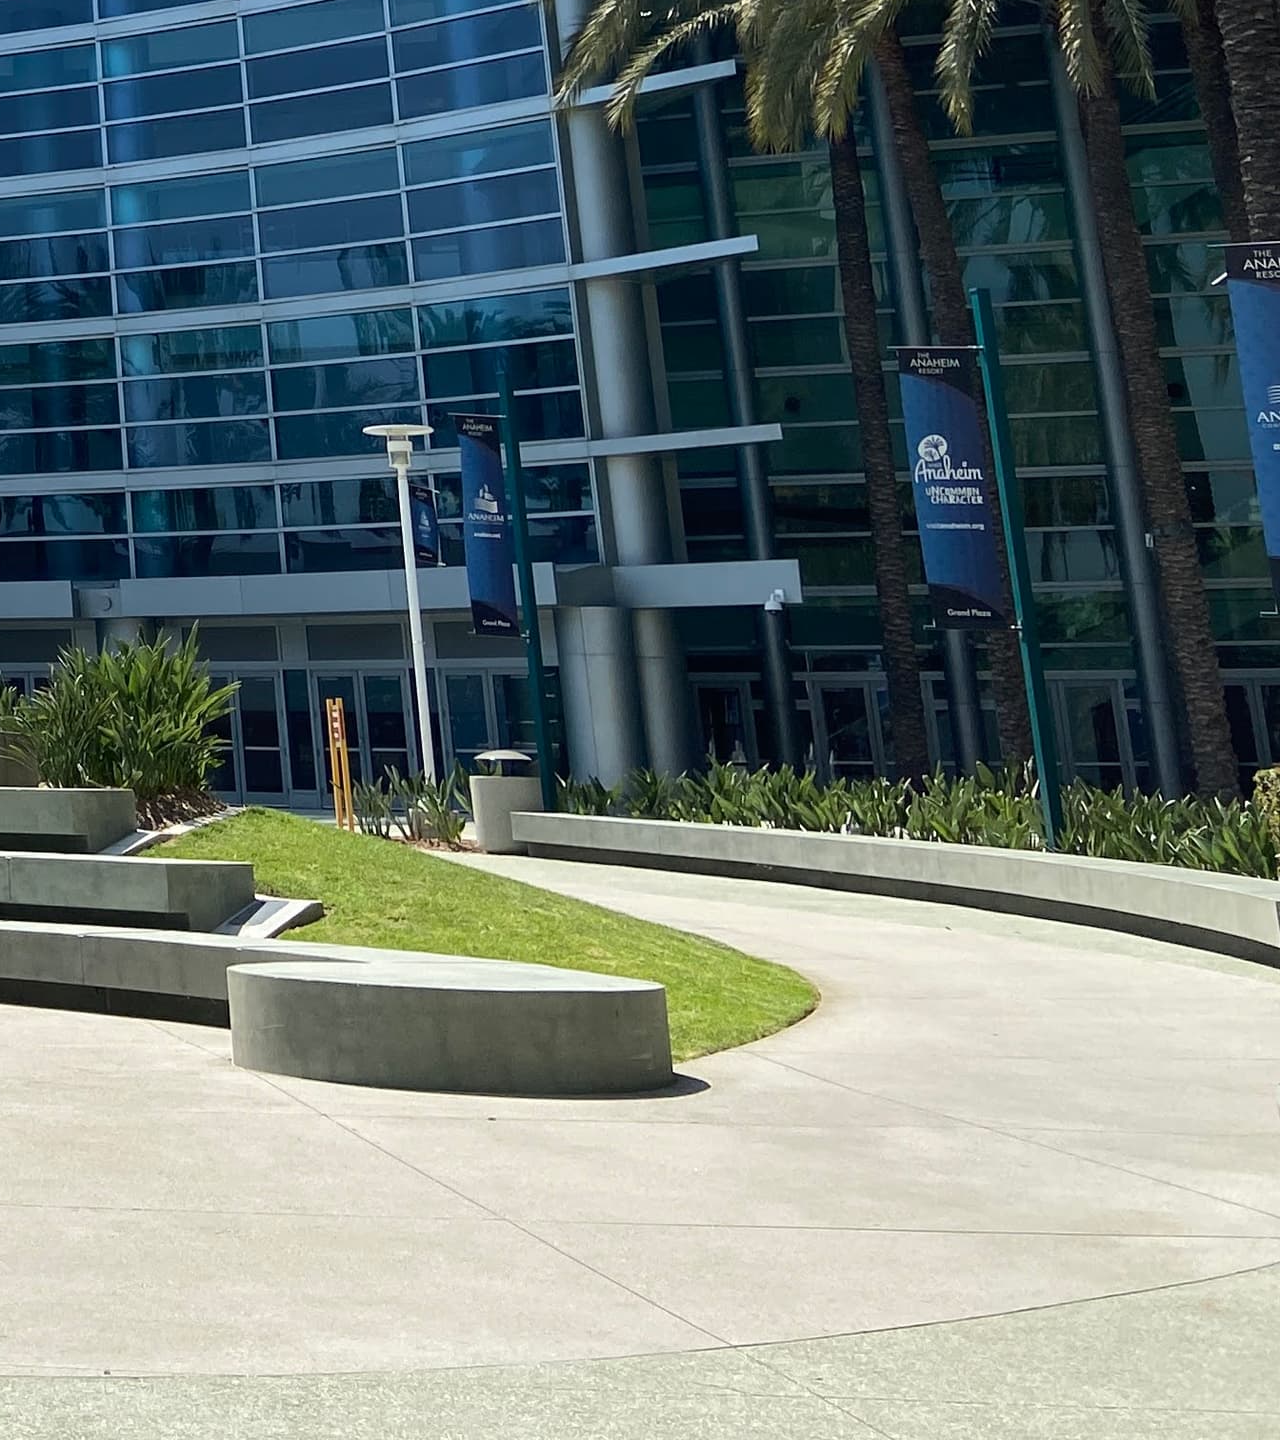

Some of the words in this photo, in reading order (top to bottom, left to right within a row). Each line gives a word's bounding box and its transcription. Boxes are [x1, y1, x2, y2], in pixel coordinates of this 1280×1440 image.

[1253, 249, 1272, 258] THE
[1243, 257, 1280, 271] ANA
[910, 358, 960, 368] ANAHEIM
[918, 367, 944, 375] RESORT
[462, 423, 494, 432] ANAHEIM
[915, 454, 984, 484] Anaheim
[931, 495, 984, 505] CHARACTER
[468, 513, 504, 522] ANAHEIM
[947, 608, 971, 616] Grand
[971, 608, 992, 617] Plaza
